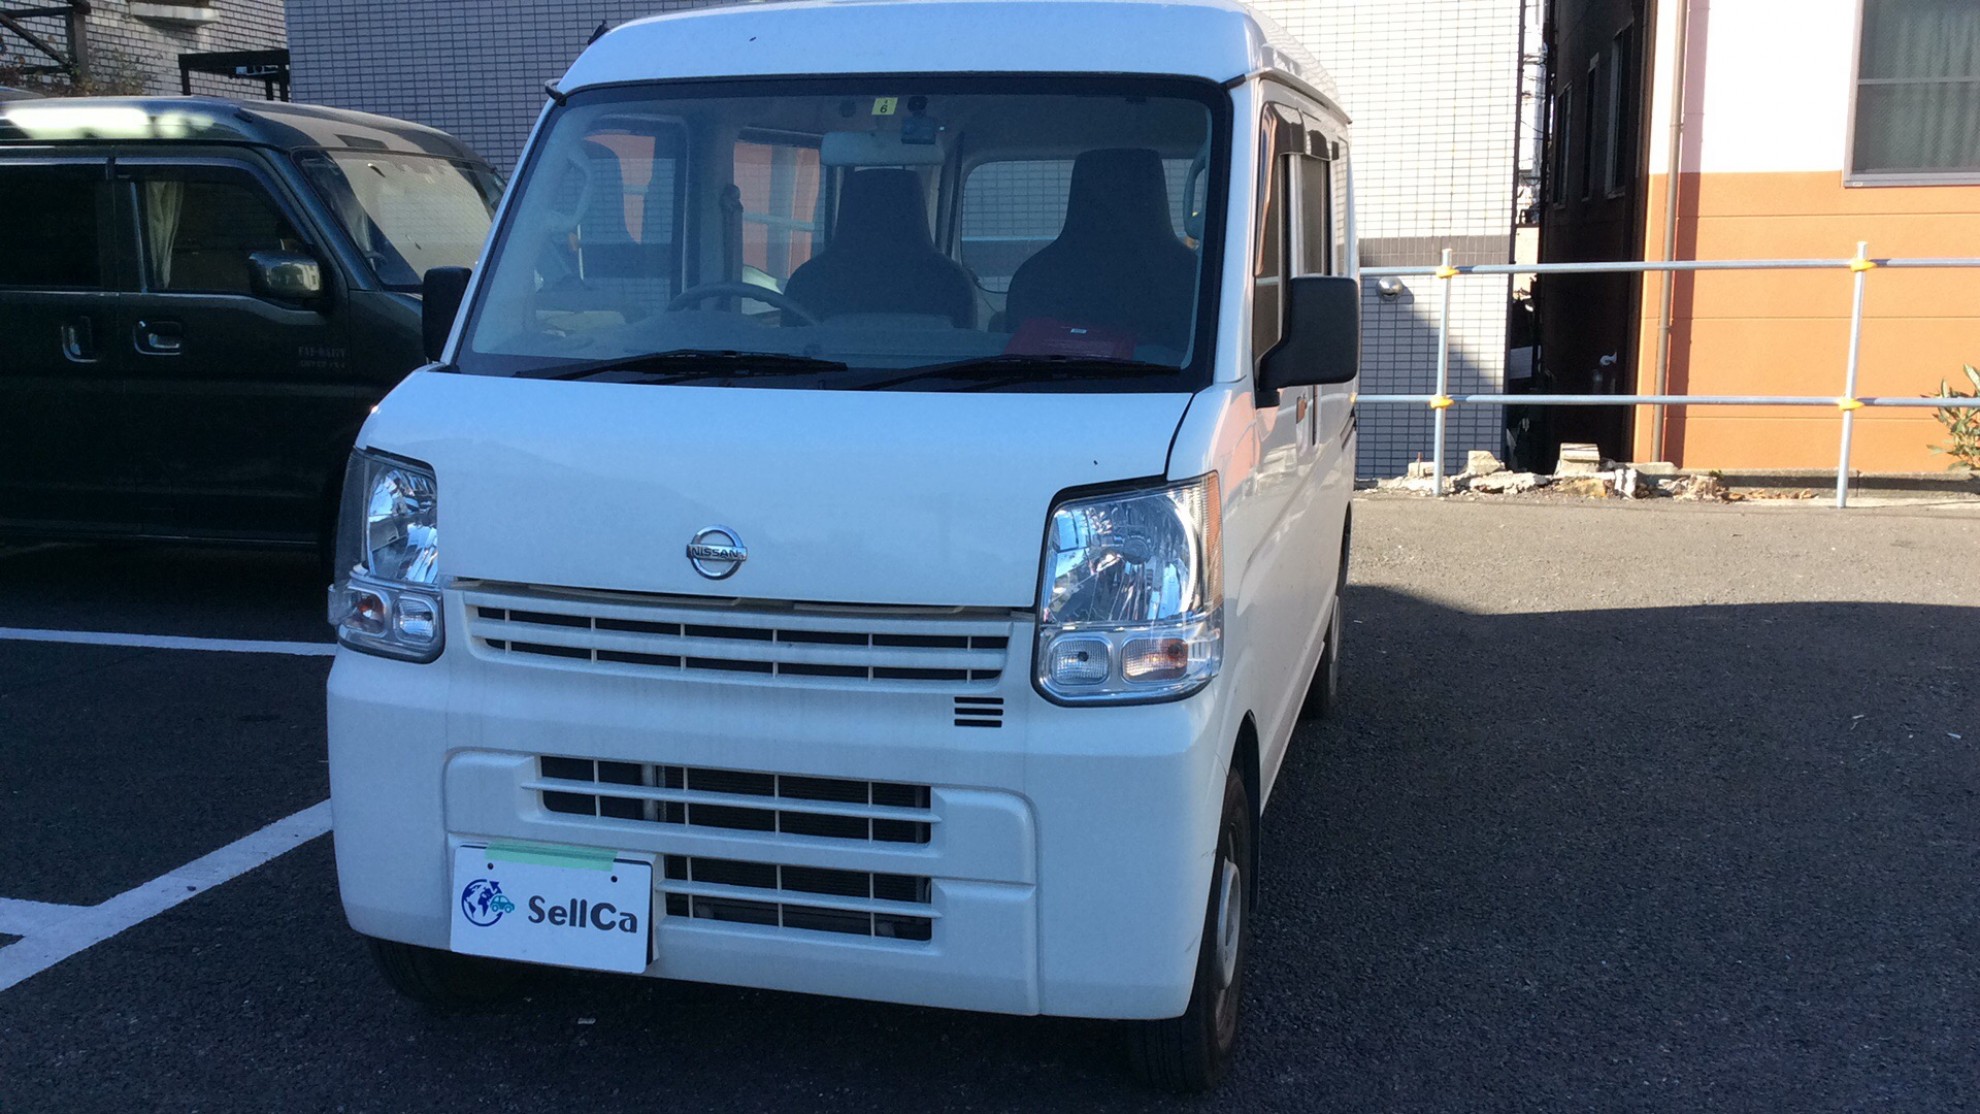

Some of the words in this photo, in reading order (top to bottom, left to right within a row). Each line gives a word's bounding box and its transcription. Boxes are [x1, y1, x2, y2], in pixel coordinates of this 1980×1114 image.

[879, 104, 888, 114] 6
[691, 547, 739, 559] NISSAN
[527, 895, 638, 934] SellCa
